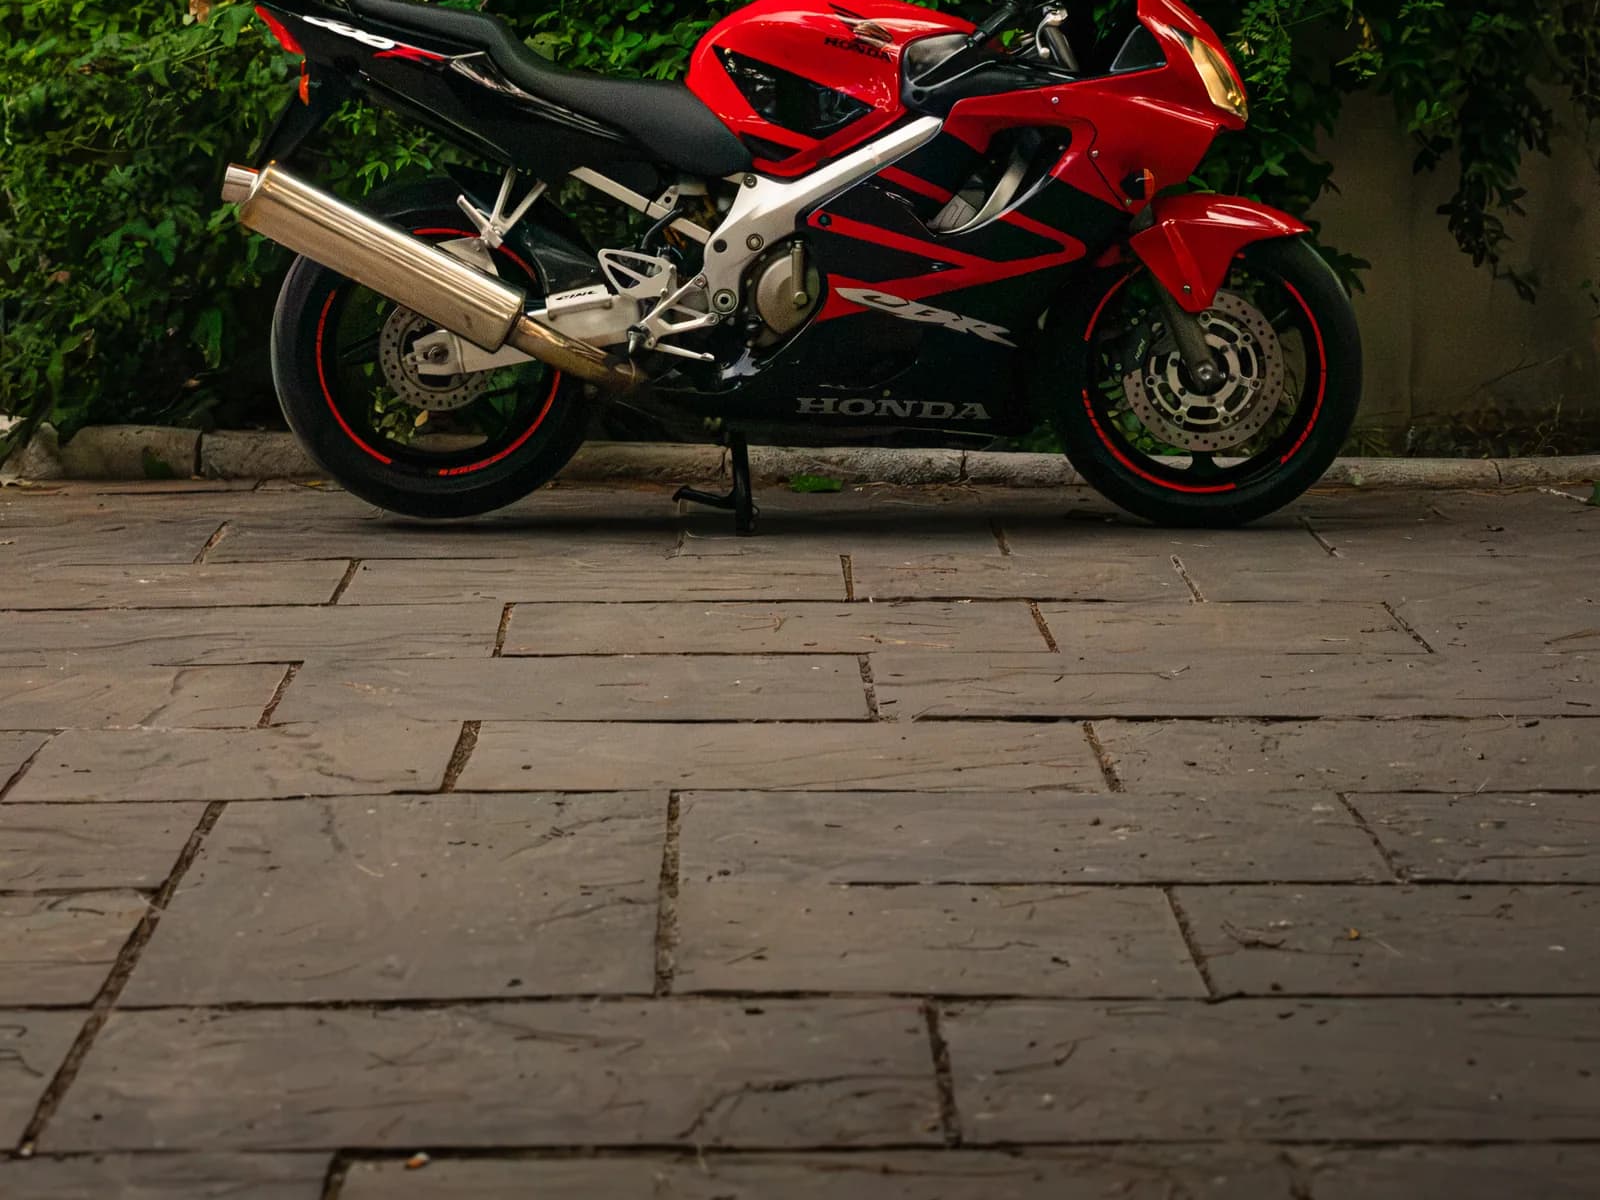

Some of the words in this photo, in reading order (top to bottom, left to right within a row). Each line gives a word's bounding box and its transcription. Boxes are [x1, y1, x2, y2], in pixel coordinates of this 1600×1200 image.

[823, 37, 892, 63] HONDA
[835, 287, 1018, 348] CBR
[795, 397, 993, 420] HONDA
